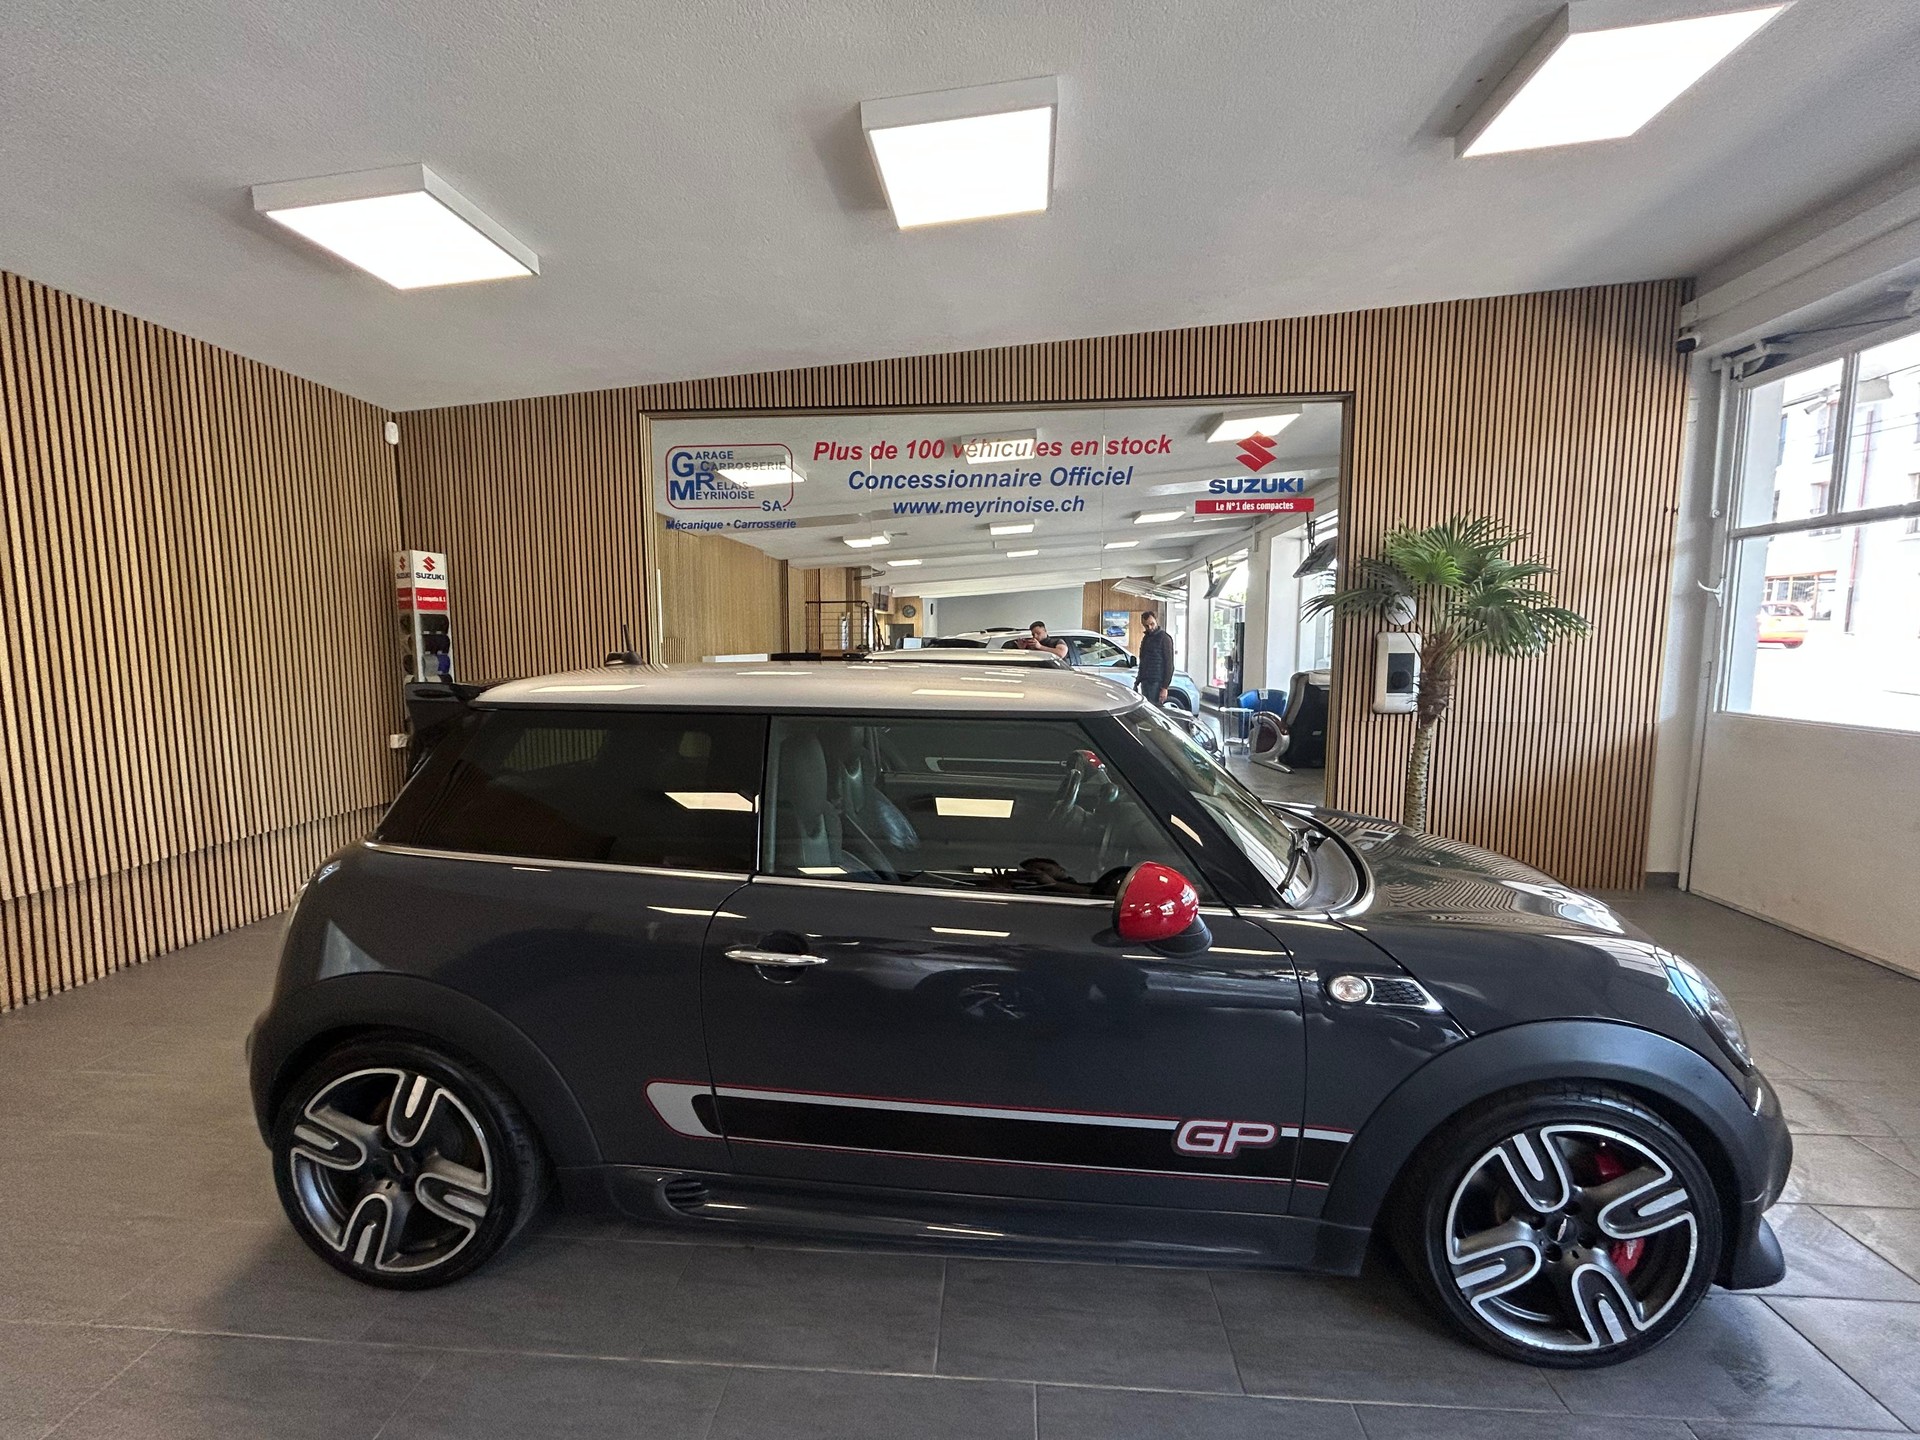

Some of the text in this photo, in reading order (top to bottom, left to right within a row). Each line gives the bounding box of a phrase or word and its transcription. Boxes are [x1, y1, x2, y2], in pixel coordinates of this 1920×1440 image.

[813, 434, 1173, 461] Plus de 100 véhicules en stock
[671, 450, 734, 478] GARAGE
[849, 465, 1134, 490] Concessionnaire Officiel
[1208, 477, 1304, 494] SUZUKI
[669, 480, 755, 501] MEYRINOISE
[893, 495, 1085, 518] www.meyrinoise.ch
[1215, 502, 1225, 512] Le
[1242, 502, 1255, 511] des
[1256, 501, 1294, 512] compactes
[665, 518, 797, 531] Mécanique Carrosserie
[415, 571, 445, 581] SUZUKI
[1176, 1119, 1276, 1154] GP
